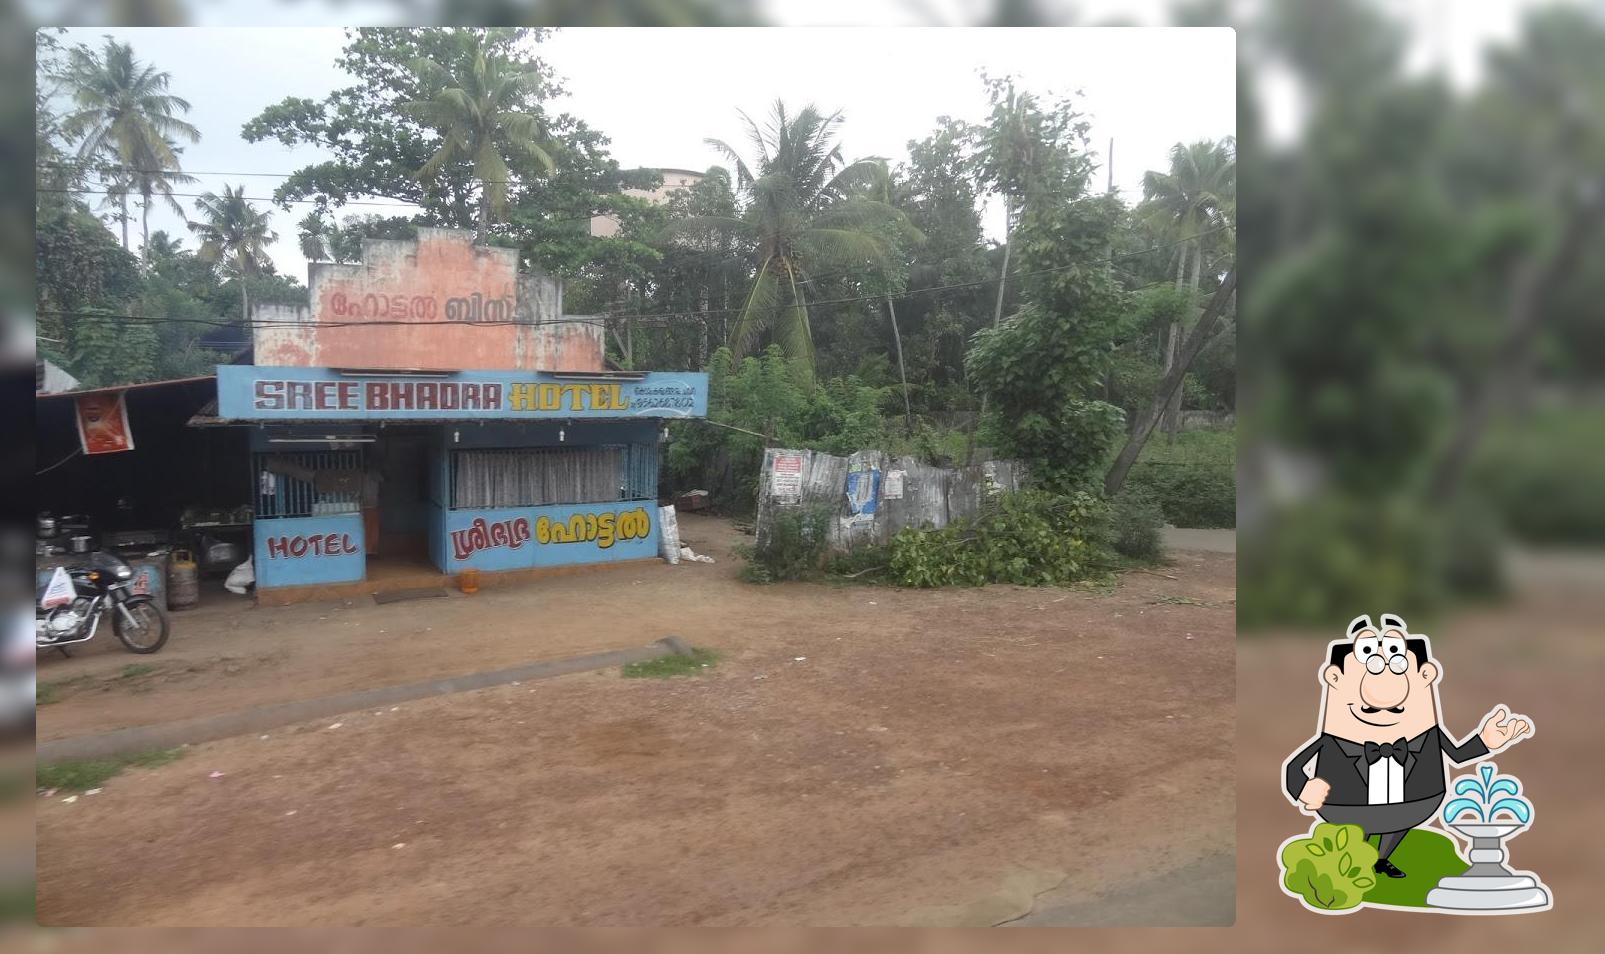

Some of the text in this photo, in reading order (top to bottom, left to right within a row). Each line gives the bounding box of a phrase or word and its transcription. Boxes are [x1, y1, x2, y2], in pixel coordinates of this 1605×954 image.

[253, 380, 630, 412] SREE BHADRA HOTEL
[534, 506, 651, 549] ഹോട്ടൽ
[265, 532, 359, 560] HOTEL
